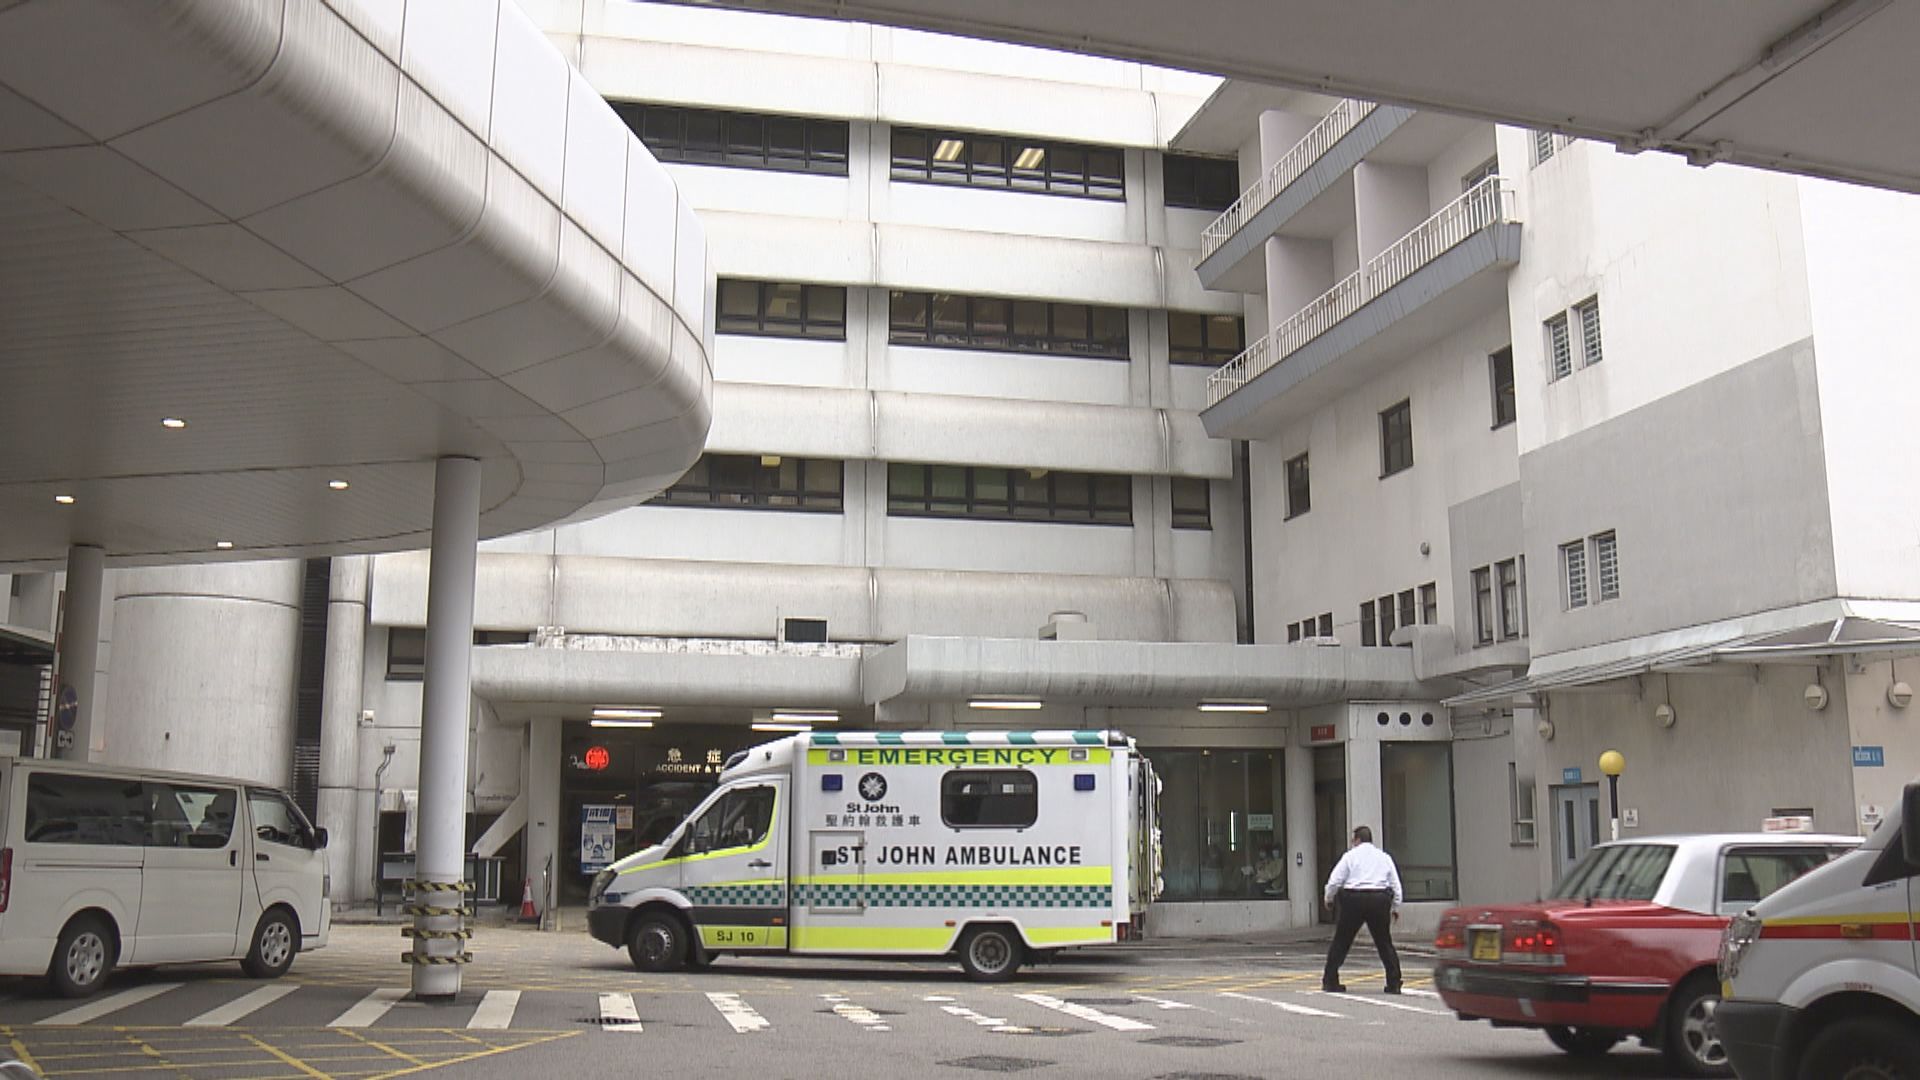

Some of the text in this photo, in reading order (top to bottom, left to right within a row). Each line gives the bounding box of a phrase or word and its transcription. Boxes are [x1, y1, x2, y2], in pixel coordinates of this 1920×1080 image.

[858, 748, 1057, 765] EMERGENCY
[655, 763, 701, 774] ACCIDENT
[704, 764, 712, 774] &
[846, 802, 900, 813] St John
[825, 814, 921, 827] 聖約翰救護車
[877, 845, 936, 865] JOHN
[945, 845, 1082, 865] AMBULANCE
[716, 930, 754, 942] SJ 10
